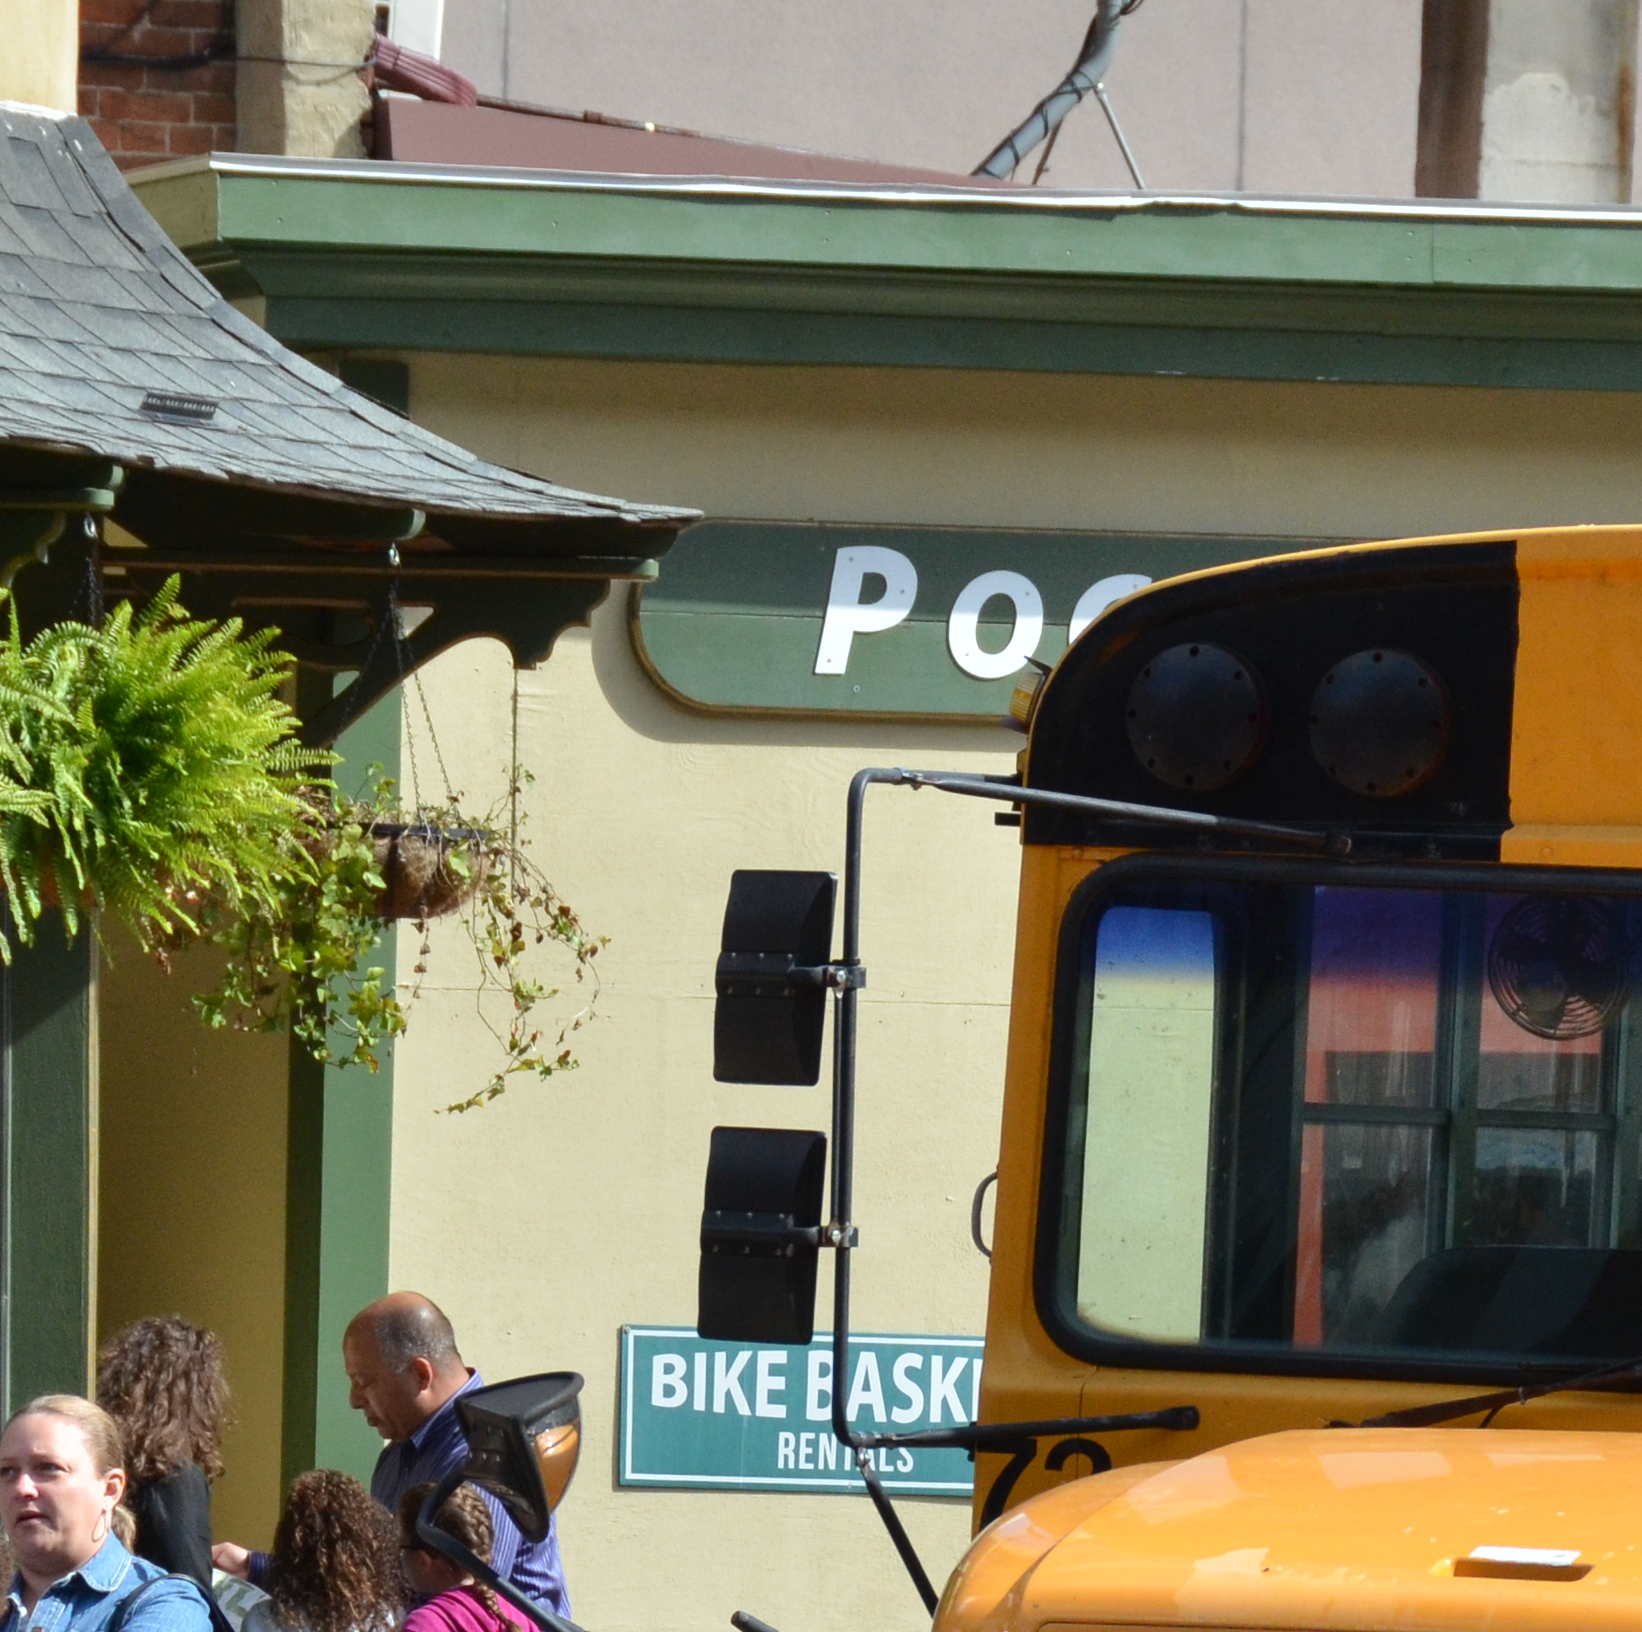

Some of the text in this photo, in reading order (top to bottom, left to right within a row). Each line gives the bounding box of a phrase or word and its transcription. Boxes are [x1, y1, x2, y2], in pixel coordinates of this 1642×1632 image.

[651, 1350, 983, 1424] BIKE BASK
[777, 1432, 914, 1473] RENLS
